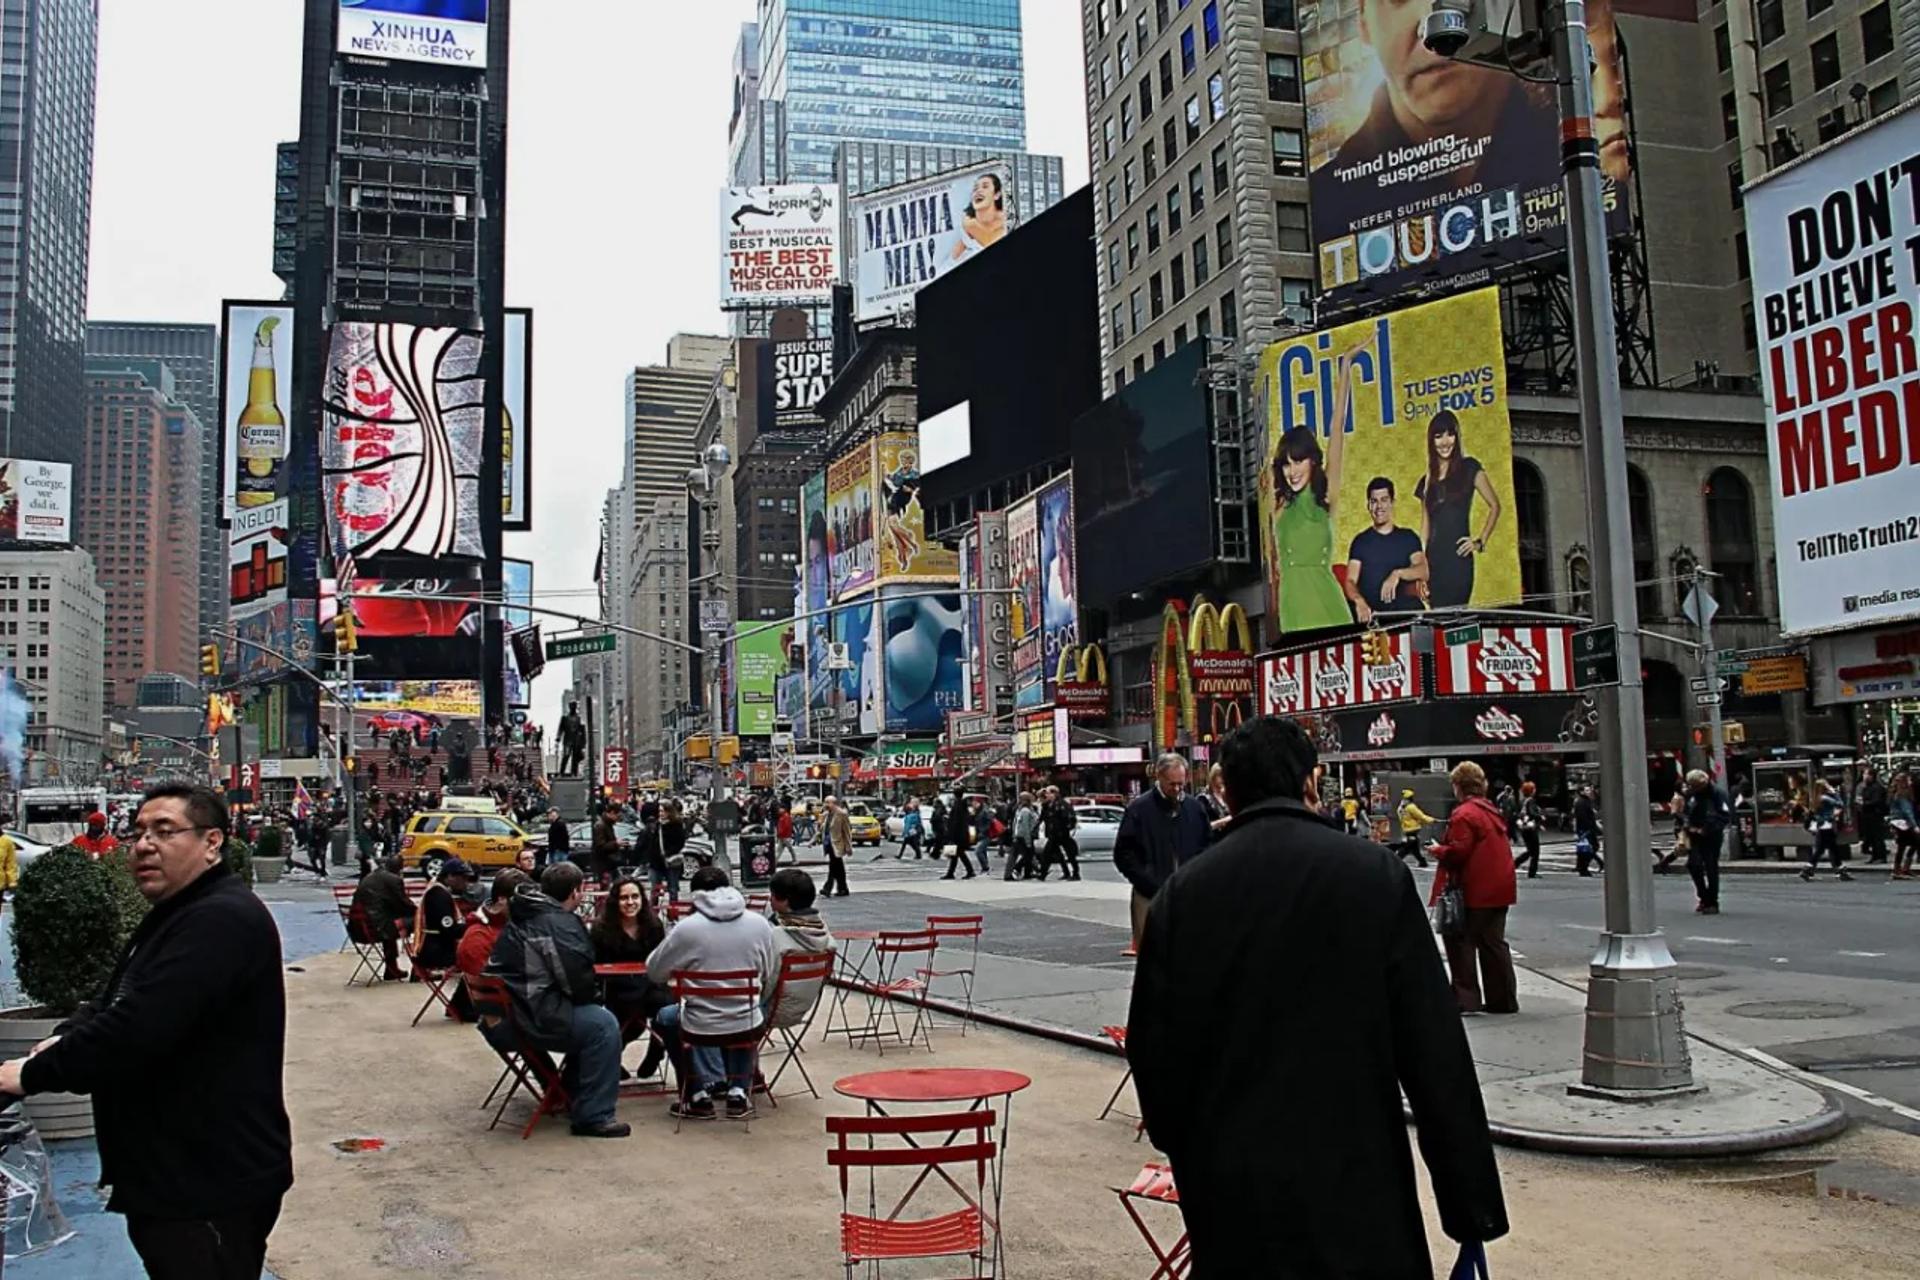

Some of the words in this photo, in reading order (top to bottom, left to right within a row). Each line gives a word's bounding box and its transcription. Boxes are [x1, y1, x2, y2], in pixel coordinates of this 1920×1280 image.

[372, 20, 456, 46] XINHUA
[351, 36, 399, 53] NEWS
[406, 43, 475, 61] AGENCY
[768, 198, 832, 211] MORMON
[1349, 210, 1393, 231] KIEFER
[1397, 182, 1484, 218] SUTHERLAND
[1525, 214, 1558, 234] 9PM
[1603, 191, 1617, 212] 5
[864, 192, 954, 252] MAMMA
[729, 238, 764, 250] BEST
[769, 236, 833, 248] MUSICAL
[1321, 189, 1520, 288] TOUCH
[778, 248, 833, 265] BEST
[884, 238, 936, 290] MIA!
[729, 265, 806, 281] MUSICAL
[808, 264, 833, 278] OF
[730, 281, 762, 292] THIS
[1764, 246, 1897, 341] BELIEVE
[774, 341, 807, 355] JESUS
[775, 352, 833, 379] SUPE
[1279, 317, 1395, 438] Girl
[1403, 366, 1494, 398] TUESDAYS
[775, 375, 833, 409] STA
[1403, 401, 1439, 421] 9PM
[1439, 391, 1476, 411] FOX
[1479, 385, 1495, 405] 5
[241, 426, 280, 440] Corona
[24, 475, 66, 490] George,
[39, 466, 52, 478] By
[29, 499, 47, 509] did
[232, 505, 284, 532] INGLOT
[1797, 515, 1920, 562] TellTheTruth2
[989, 525, 1007, 669] PALACE
[1860, 590, 1898, 607] media
[555, 639, 606, 656] Broadway
[1193, 658, 1254, 668] McDonald's
[1373, 663, 1401, 681] FRIDAYS
[1486, 657, 1534, 673] FRIDAYS
[1058, 688, 1109, 696] McDonald's
[1320, 673, 1345, 690] FRIDAYS
[607, 751, 624, 783] tkts
